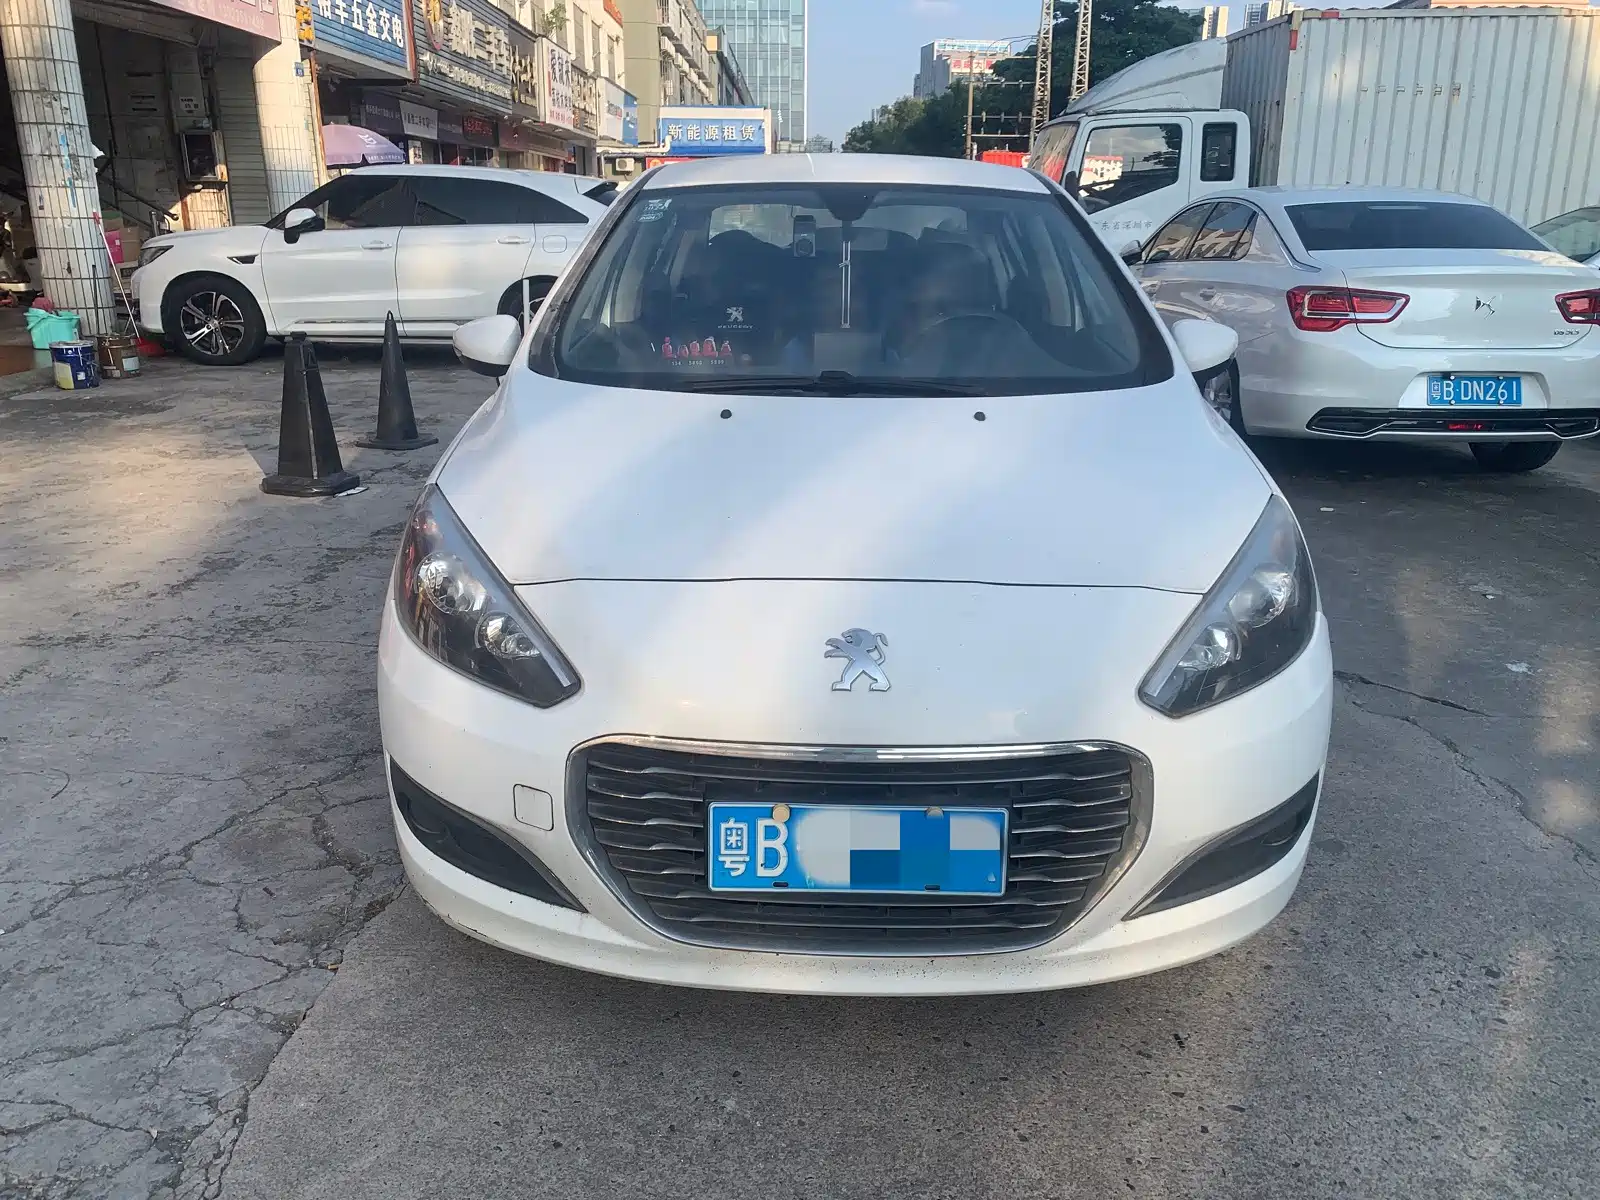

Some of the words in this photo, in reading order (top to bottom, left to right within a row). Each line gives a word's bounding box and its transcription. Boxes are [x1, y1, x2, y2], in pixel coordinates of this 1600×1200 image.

[667, 123, 756, 142] 新能源租赁
